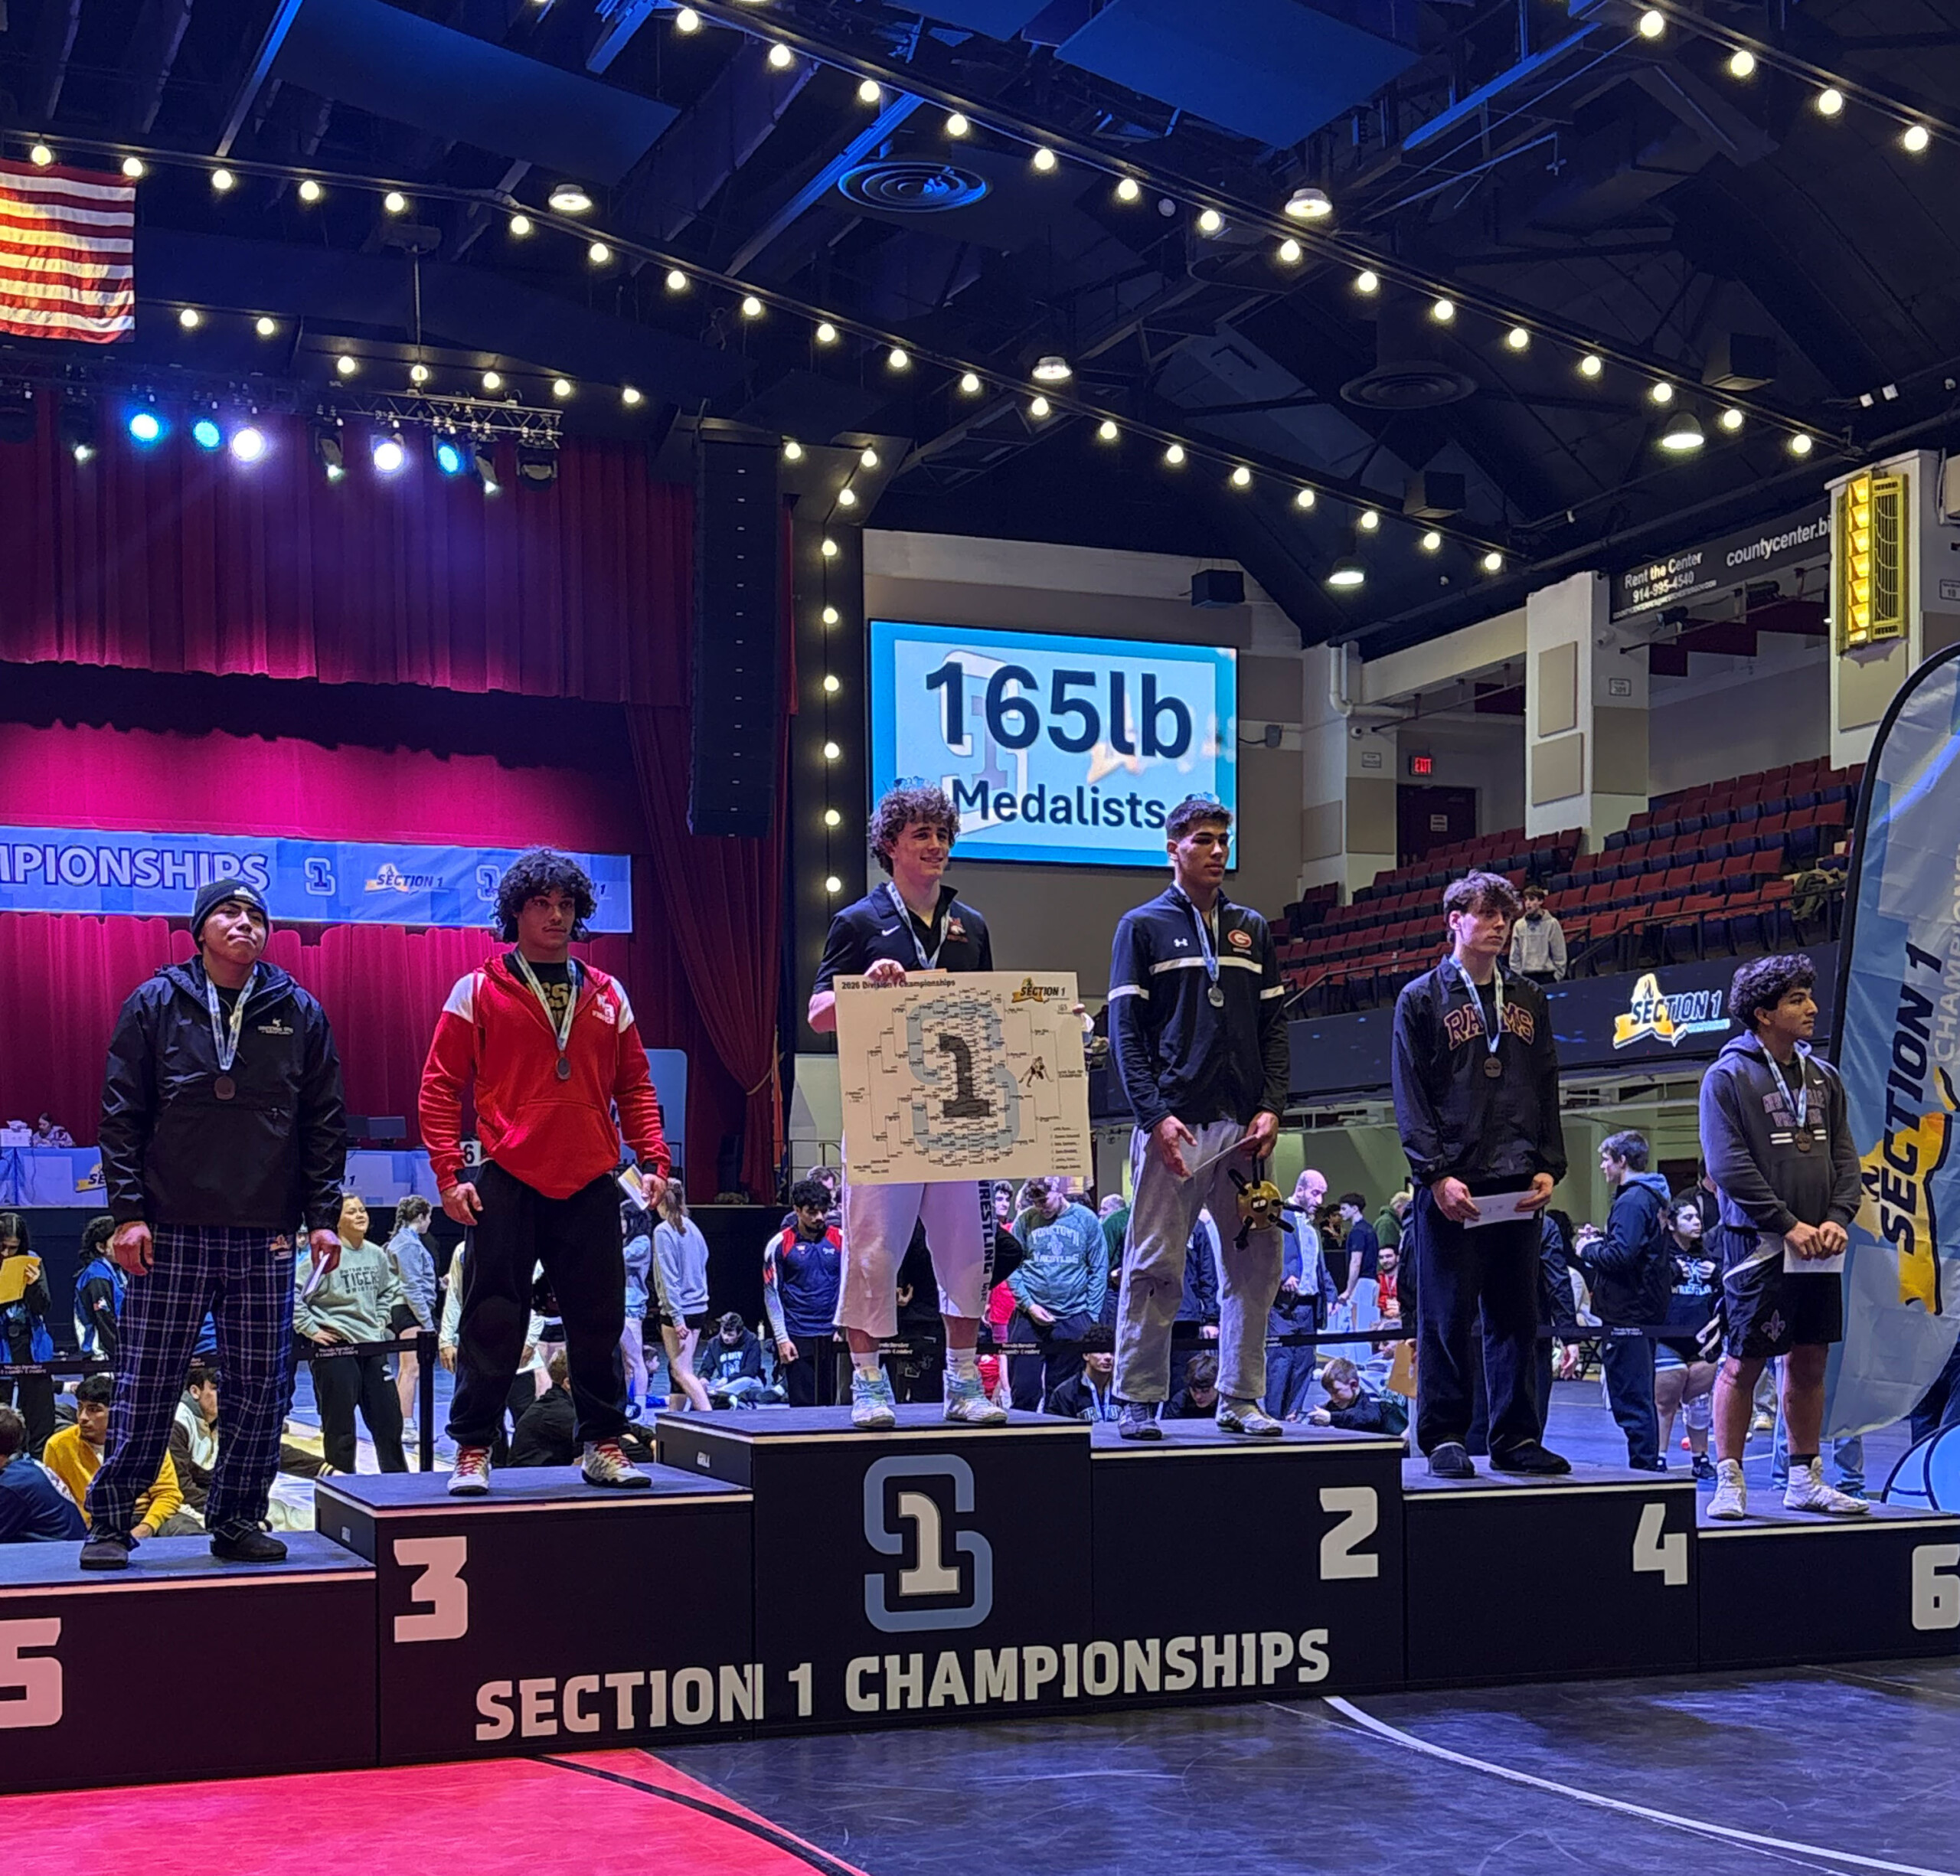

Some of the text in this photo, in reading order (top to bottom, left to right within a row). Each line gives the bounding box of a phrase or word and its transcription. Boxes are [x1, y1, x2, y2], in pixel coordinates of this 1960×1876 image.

[1624, 552, 1703, 589] Rent the Center
[926, 662, 1192, 759] 165lb
[952, 779, 1165, 829] Medalists
[376, 874, 444, 887] SECTION 1
[1020, 986, 1066, 996] SECTION 1
[1444, 1002, 1534, 1051] RAMS
[1630, 990, 1710, 1026] SECTION
[1711, 989, 1722, 1018] 1
[1880, 941, 1942, 1255] SECTION 1
[1319, 1486, 1378, 1580] 2
[1632, 1503, 1688, 1586] 4
[393, 1536, 469, 1643] 3
[1912, 1544, 1960, 1631] 6
[0, 1616, 62, 1729] 5
[475, 1629, 1330, 1741] SECTION 1 CHAMPIONSHIPS
